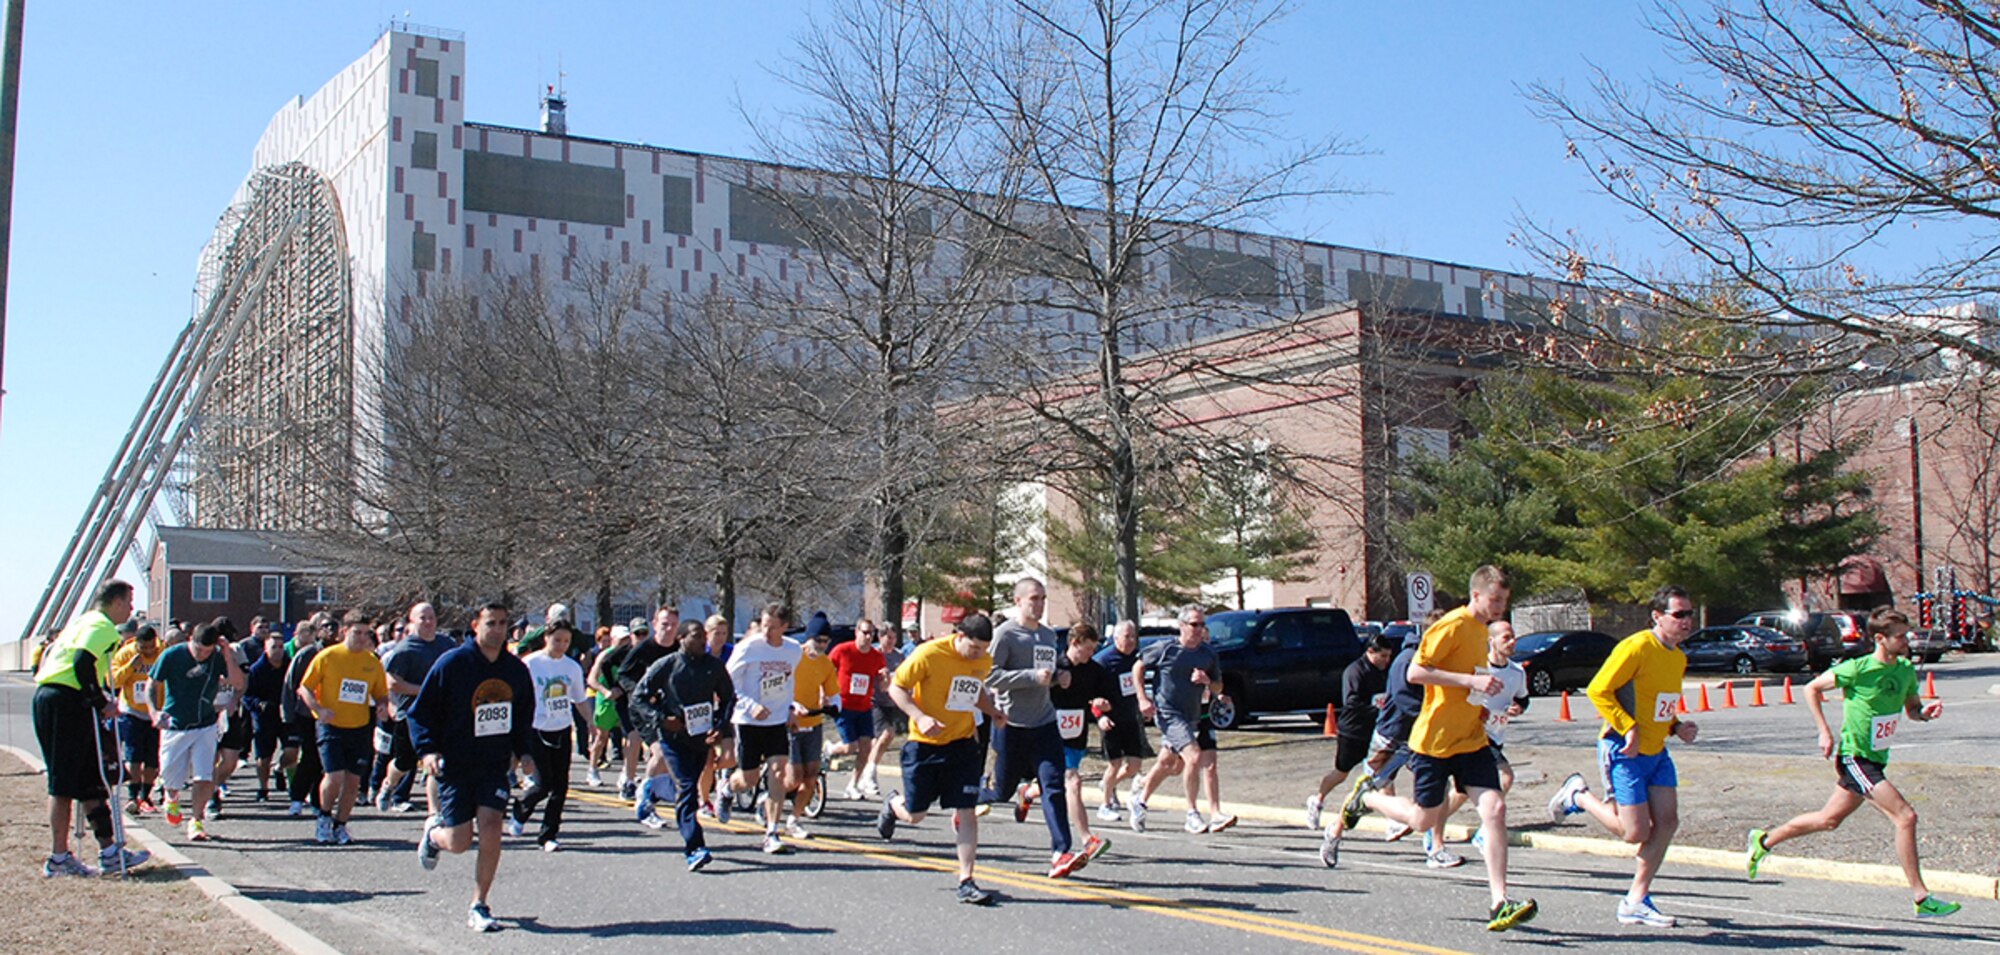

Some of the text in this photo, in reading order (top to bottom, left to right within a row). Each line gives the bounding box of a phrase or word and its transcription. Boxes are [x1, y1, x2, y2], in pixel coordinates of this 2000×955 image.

[953, 680, 979, 694] 1925
[478, 706, 508, 722] 2093
[1060, 715, 1080, 729] 254
[1876, 720, 1897, 739] 260
